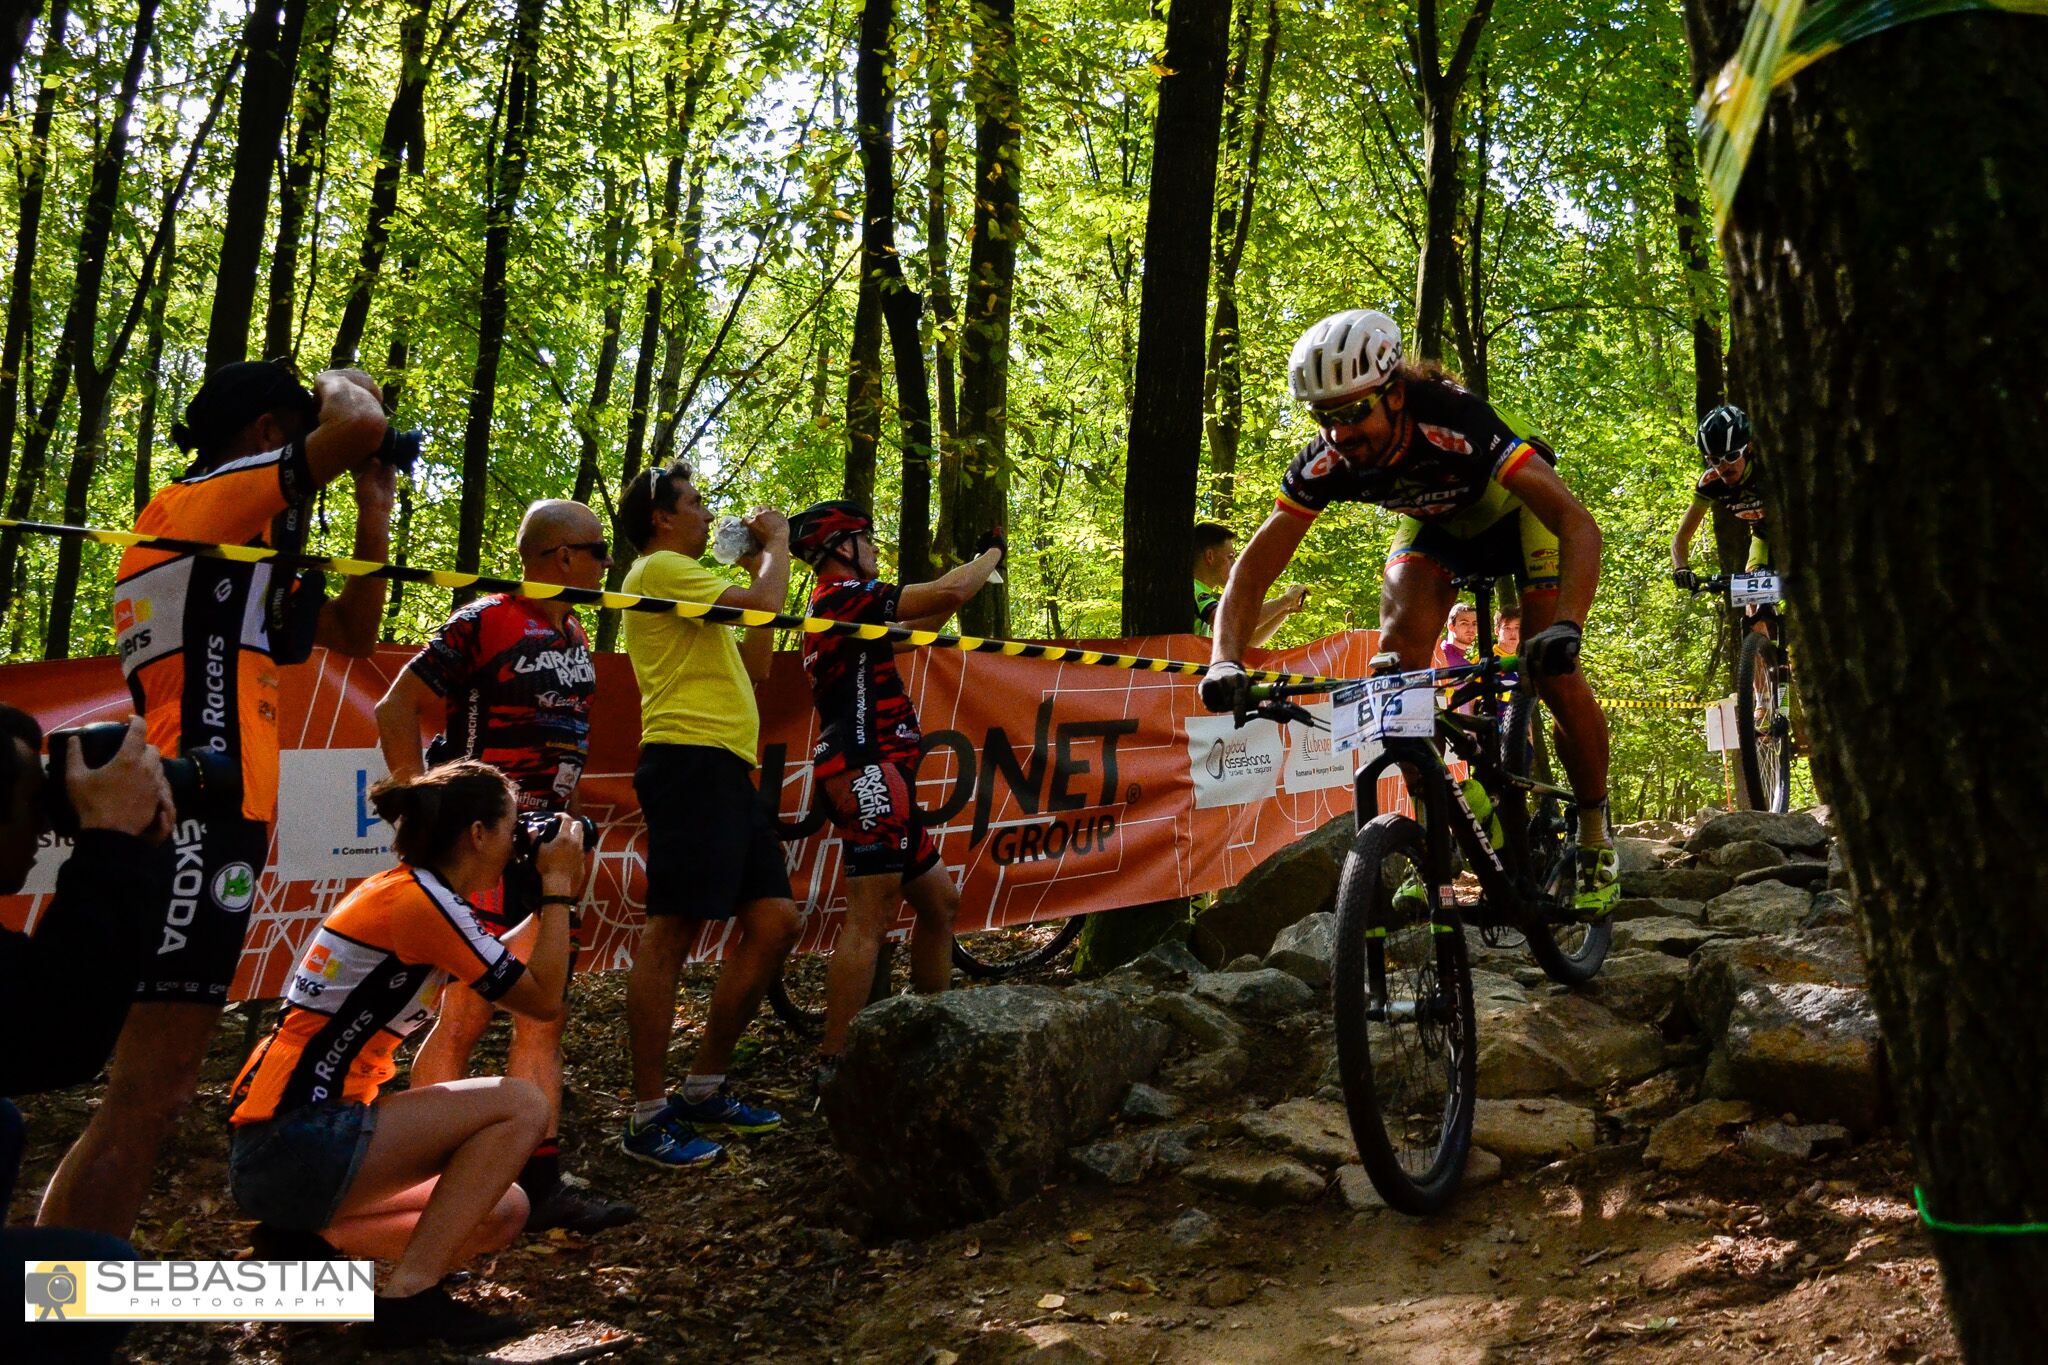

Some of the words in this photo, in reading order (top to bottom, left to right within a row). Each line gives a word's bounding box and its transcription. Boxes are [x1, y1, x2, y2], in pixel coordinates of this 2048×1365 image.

[1747, 577, 1773, 593] 84
[202, 634, 226, 723] Racers
[555, 662, 596, 688] RACIN
[1224, 753, 1272, 769] assistance
[341, 846, 379, 856] Comert
[990, 814, 1116, 867] GROUP
[315, 1009, 374, 1082] Racers
